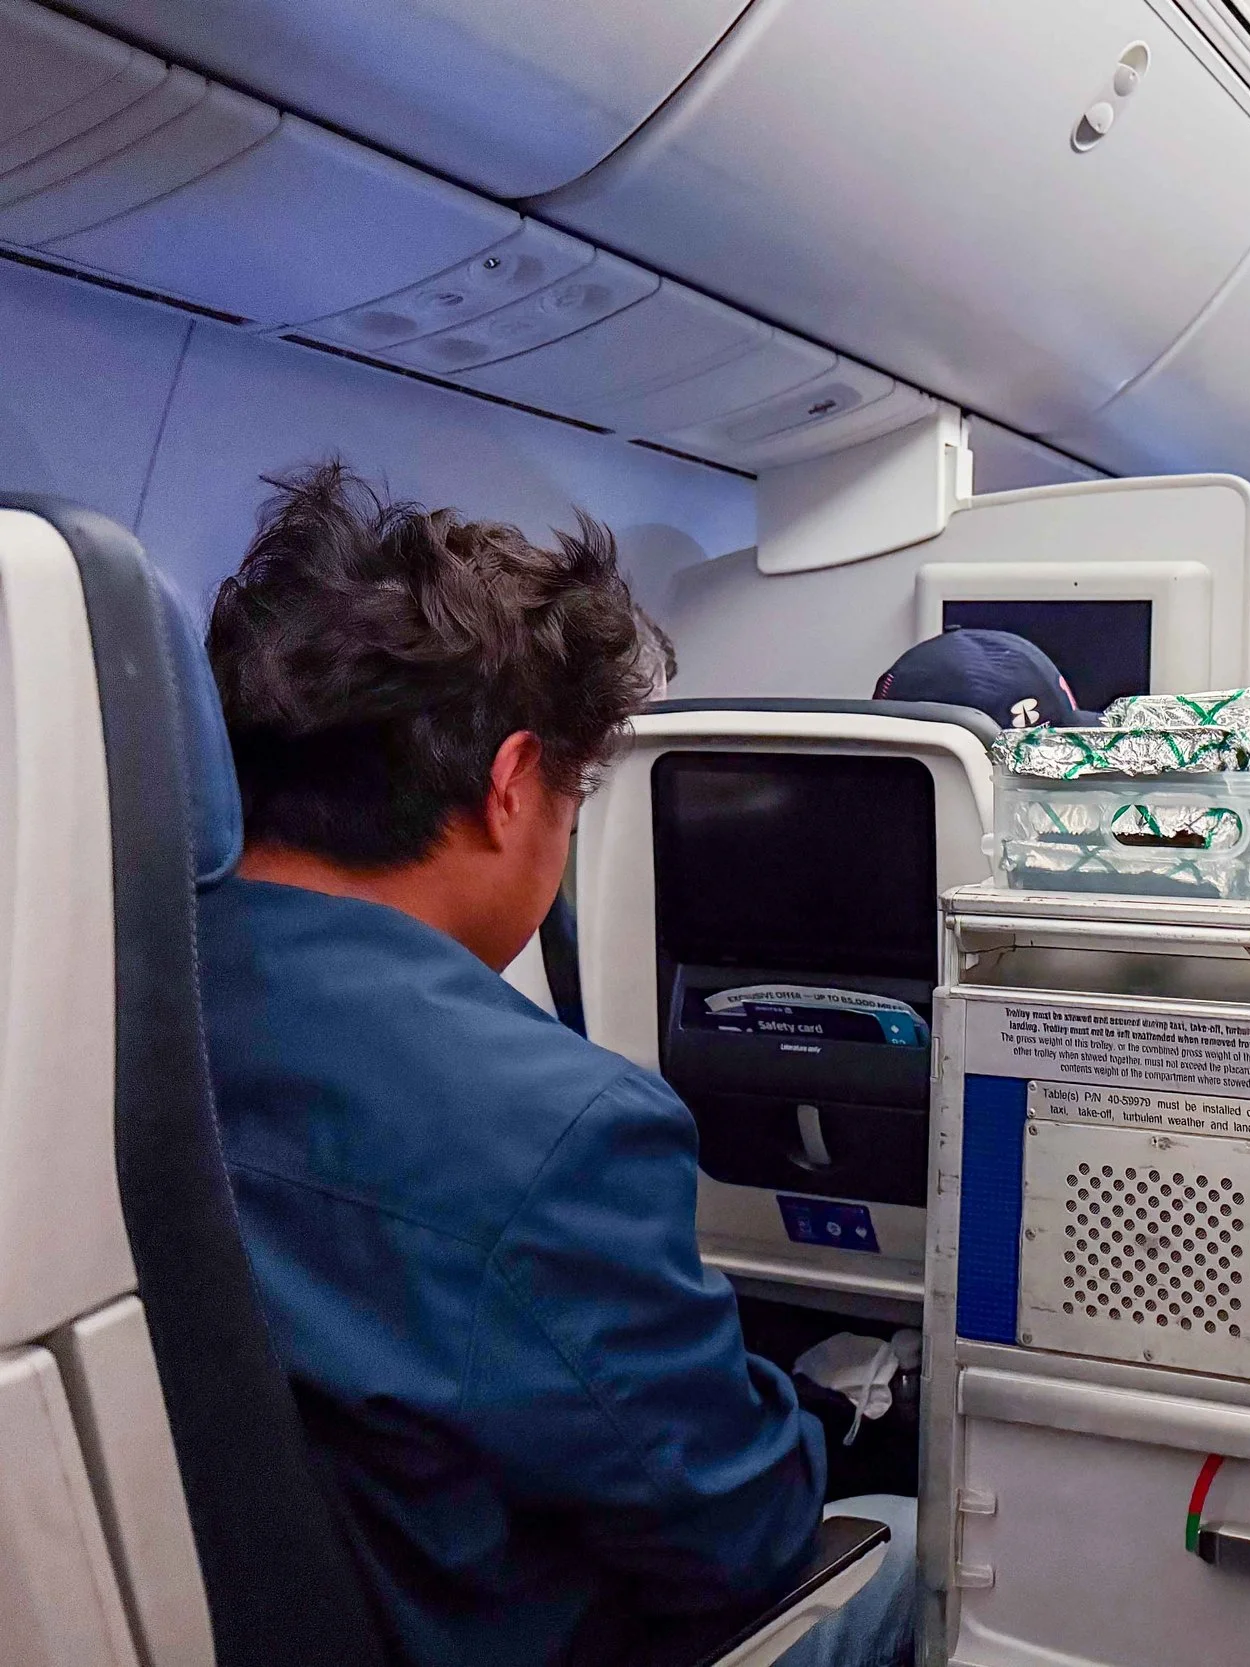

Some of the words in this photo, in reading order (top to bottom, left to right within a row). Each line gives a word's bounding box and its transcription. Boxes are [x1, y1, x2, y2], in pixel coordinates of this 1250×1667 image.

[727, 991, 774, 1003] EXCLUSIVE
[827, 994, 840, 1002] TO
[758, 1020, 795, 1033] Safety
[798, 1024, 824, 1034] card
[1005, 1008, 1030, 1020] Trolley
[1032, 1011, 1050, 1020] must
[1052, 1011, 1062, 1020] be
[1064, 1013, 1092, 1023] stowed
[1093, 1015, 1108, 1024] and
[1109, 1016, 1141, 1027] secured
[1142, 1018, 1168, 1030] during
[1001, 1032, 1014, 1042] The
[1016, 1034, 1036, 1045] gross
[1038, 1036, 1063, 1048] weight
[1065, 1037, 1073, 1047] of
[1074, 1038, 1088, 1048] this
[1118, 1042, 1126, 1050] or
[1128, 1042, 1140, 1052] the
[1142, 1044, 1179, 1056] combined
[1181, 1049, 1202, 1058] gross
[1204, 1050, 1231, 1062] weight
[1234, 1052, 1241, 1060] of
[1043, 1022, 1068, 1036] Trolley
[1070, 1026, 1090, 1036] must
[1091, 1028, 1104, 1037] not
[1104, 1028, 1115, 1038] be
[1117, 1030, 1130, 1039] left
[1132, 1030, 1176, 1042] unattended
[1178, 1034, 1199, 1044] when
[1200, 1036, 1236, 1048] removed
[808, 1044, 822, 1054] only
[1013, 1046, 1032, 1056] other
[1034, 1048, 1056, 1060] trolley
[1058, 1050, 1079, 1060] when
[1080, 1052, 1108, 1062] stowed
[1144, 1058, 1164, 1067] must
[1166, 1058, 1178, 1068] not
[1180, 1061, 1208, 1072] exceed
[1209, 1062, 1221, 1072] the
[1060, 1064, 1092, 1074] contents
[1094, 1066, 1119, 1078] weight
[1121, 1068, 1130, 1077] of
[1130, 1069, 1143, 1078] the
[1144, 1070, 1196, 1084] compartment
[1198, 1074, 1221, 1086] where
[1043, 1088, 1079, 1103] Table(s)
[1084, 1091, 1102, 1102] P/N
[1108, 1094, 1151, 1107] 40-59979
[1158, 1100, 1180, 1110] must
[1185, 1101, 1197, 1112] be
[1202, 1102, 1241, 1116] installed
[1078, 1106, 1114, 1122] take-off,
[1123, 1111, 1163, 1124] turbulent
[1168, 1116, 1205, 1128] weather
[1210, 1120, 1229, 1132] and
